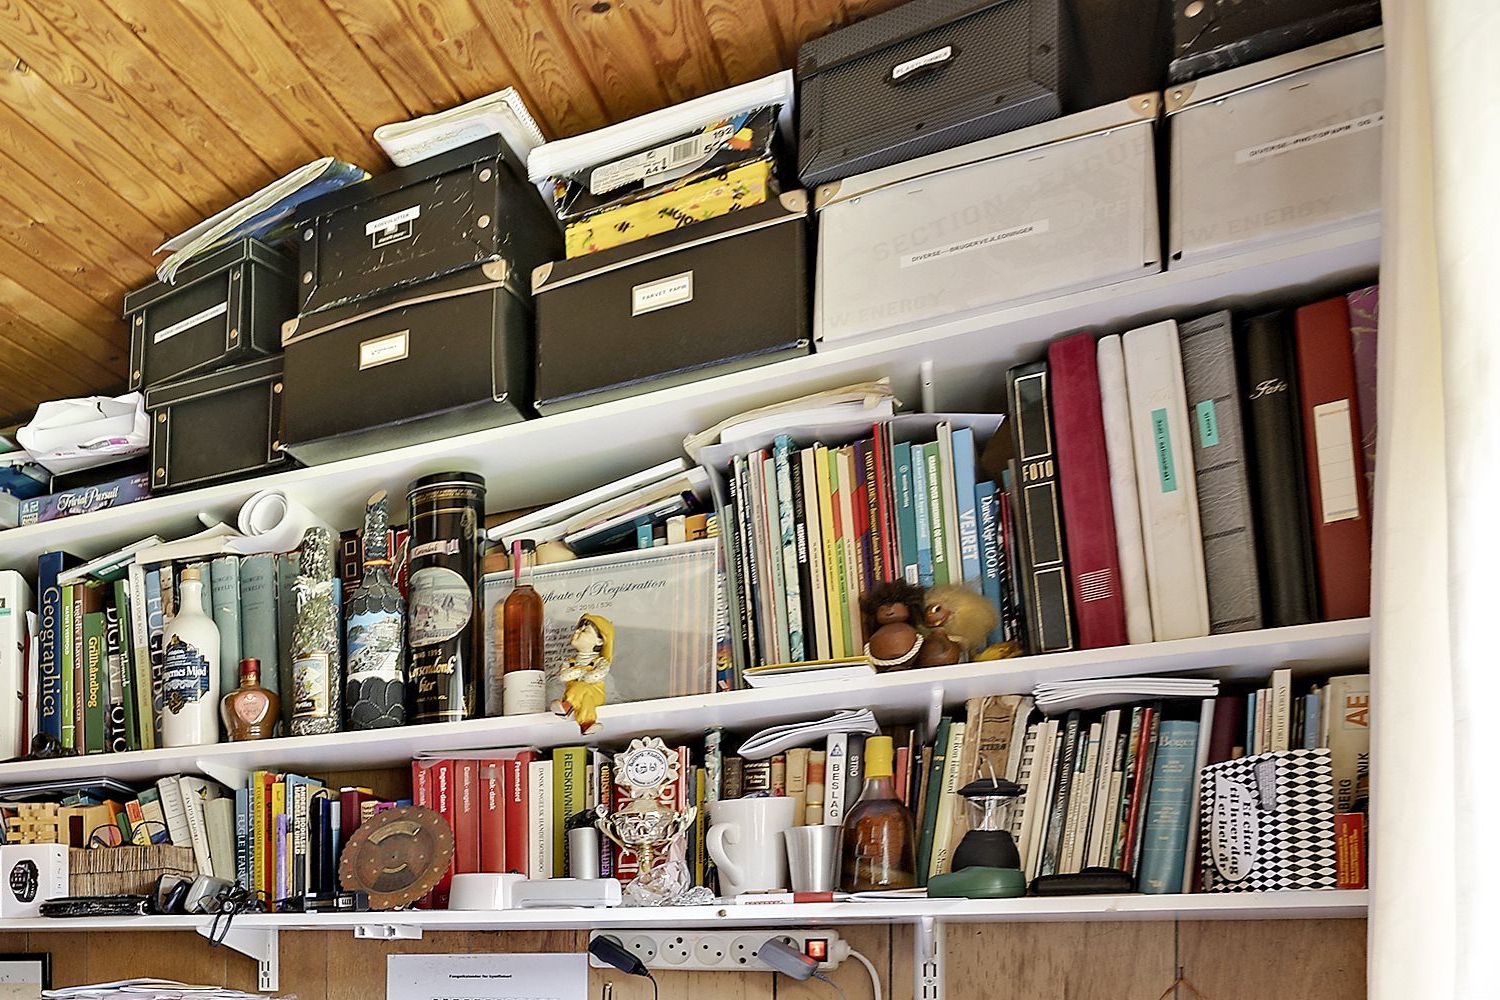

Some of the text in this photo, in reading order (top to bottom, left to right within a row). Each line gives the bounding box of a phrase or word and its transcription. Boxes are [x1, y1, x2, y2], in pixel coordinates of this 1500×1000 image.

[713, 127, 733, 139] 192
[1250, 378, 1289, 399] Foto
[1022, 461, 1054, 482] FOTO
[57, 486, 120, 511] Trivial Pursuit
[960, 508, 978, 561] VEJRET
[590, 579, 668, 600] Registration
[39, 586, 61, 718] Geographica
[106, 607, 123, 690] DIGITAL
[88, 636, 101, 708] Grillhåndbog
[418, 675, 436, 694] bier
[439, 767, 447, 813] Engelsk-dansk
[463, 766, 471, 813] Dansk-engelsk
[830, 764, 840, 818] BESLAG
[237, 813, 246, 847] FUGLE
